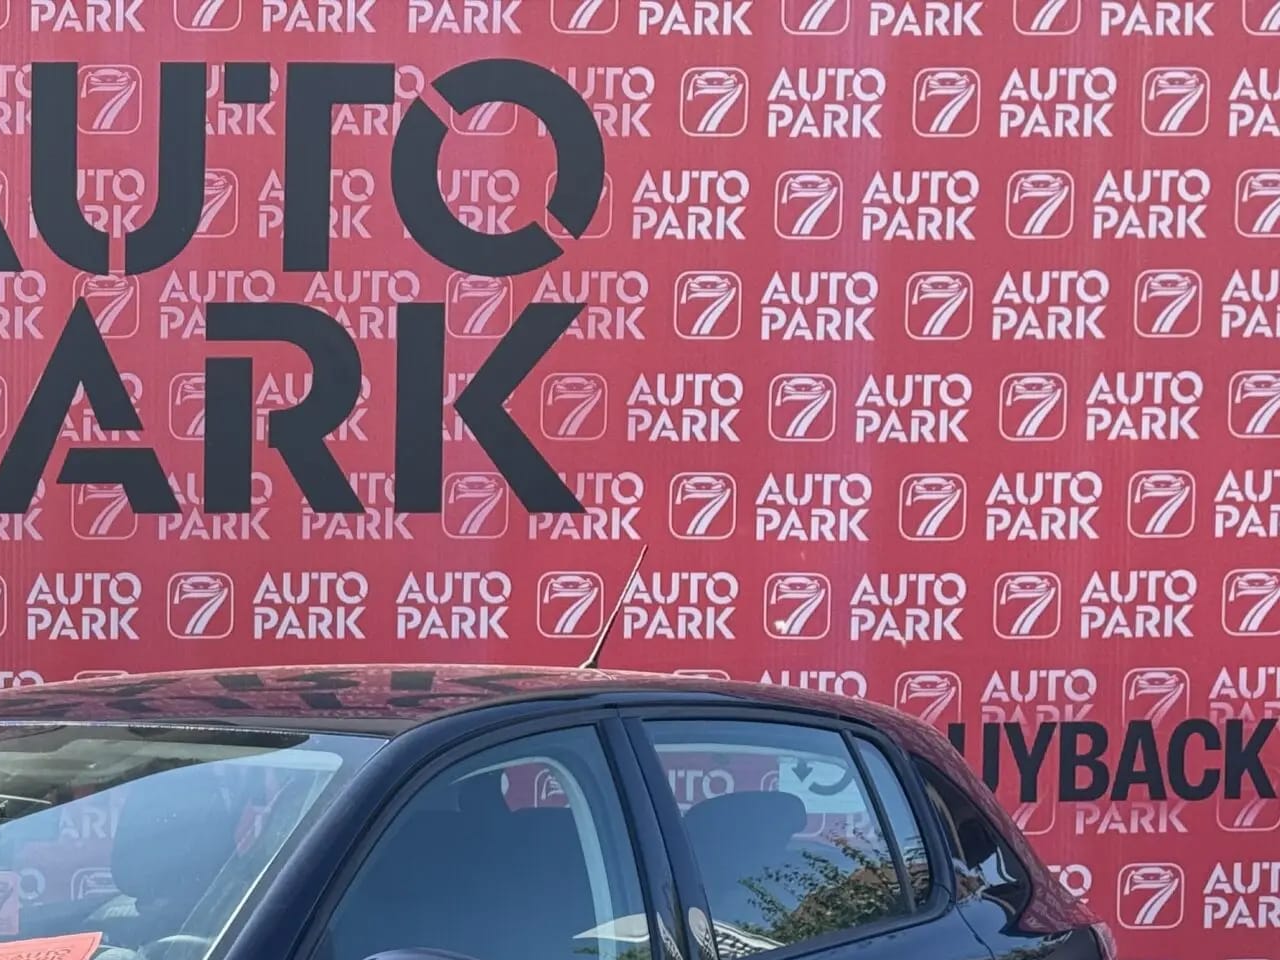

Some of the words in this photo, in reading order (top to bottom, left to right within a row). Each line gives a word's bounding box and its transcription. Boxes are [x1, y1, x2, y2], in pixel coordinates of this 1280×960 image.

[30, 0, 145, 33] PARK
[262, 0, 376, 33] PARK
[408, 0, 522, 35] PARK
[638, 0, 752, 36] PARK
[869, 1, 984, 37] PARK
[1100, 0, 1214, 37] PARK
[767, 67, 886, 102] AUTO
[999, 67, 1117, 102] AUTO
[768, 103, 883, 139] PARK
[1000, 103, 1114, 138] PARK
[632, 169, 750, 204] AUTO
[862, 169, 980, 205] AUTO
[1093, 169, 1210, 203] AUTO
[632, 205, 745, 240] PARK
[862, 206, 976, 241] PARK
[1093, 204, 1207, 239] PARK
[159, 270, 276, 304] AUTO
[303, 270, 420, 303] AUTO
[532, 270, 649, 304] AUTO
[761, 271, 879, 306] AUTO
[992, 269, 1109, 305] AUTO
[761, 306, 875, 341] PARK
[992, 305, 1106, 340] PARK
[626, 373, 743, 407] AUTO
[855, 373, 973, 408] AUTO
[1086, 371, 1204, 406] AUTO
[627, 408, 740, 442] PARK
[855, 408, 969, 444] PARK
[1086, 407, 1200, 441] PARK
[755, 472, 872, 507] AUTO
[986, 471, 1103, 506] AUTO
[158, 509, 269, 541] PARK
[302, 509, 414, 541] PARK
[529, 510, 641, 541] PARK
[756, 507, 870, 542] PARK
[986, 506, 1100, 541] PARK
[26, 572, 142, 605] AUTO
[254, 571, 370, 605] AUTO
[396, 571, 512, 604] AUTO
[623, 570, 738, 604] AUTO
[850, 572, 967, 607] AUTO
[1080, 569, 1197, 604] AUTO
[27, 606, 140, 640] PARK
[254, 606, 366, 640] PARK
[397, 605, 509, 640] PARK
[623, 606, 736, 640] PARK
[850, 607, 964, 642] PARK
[1080, 604, 1194, 639] PARK
[981, 670, 1097, 703] AUTO
[1075, 802, 1189, 835] PARK
